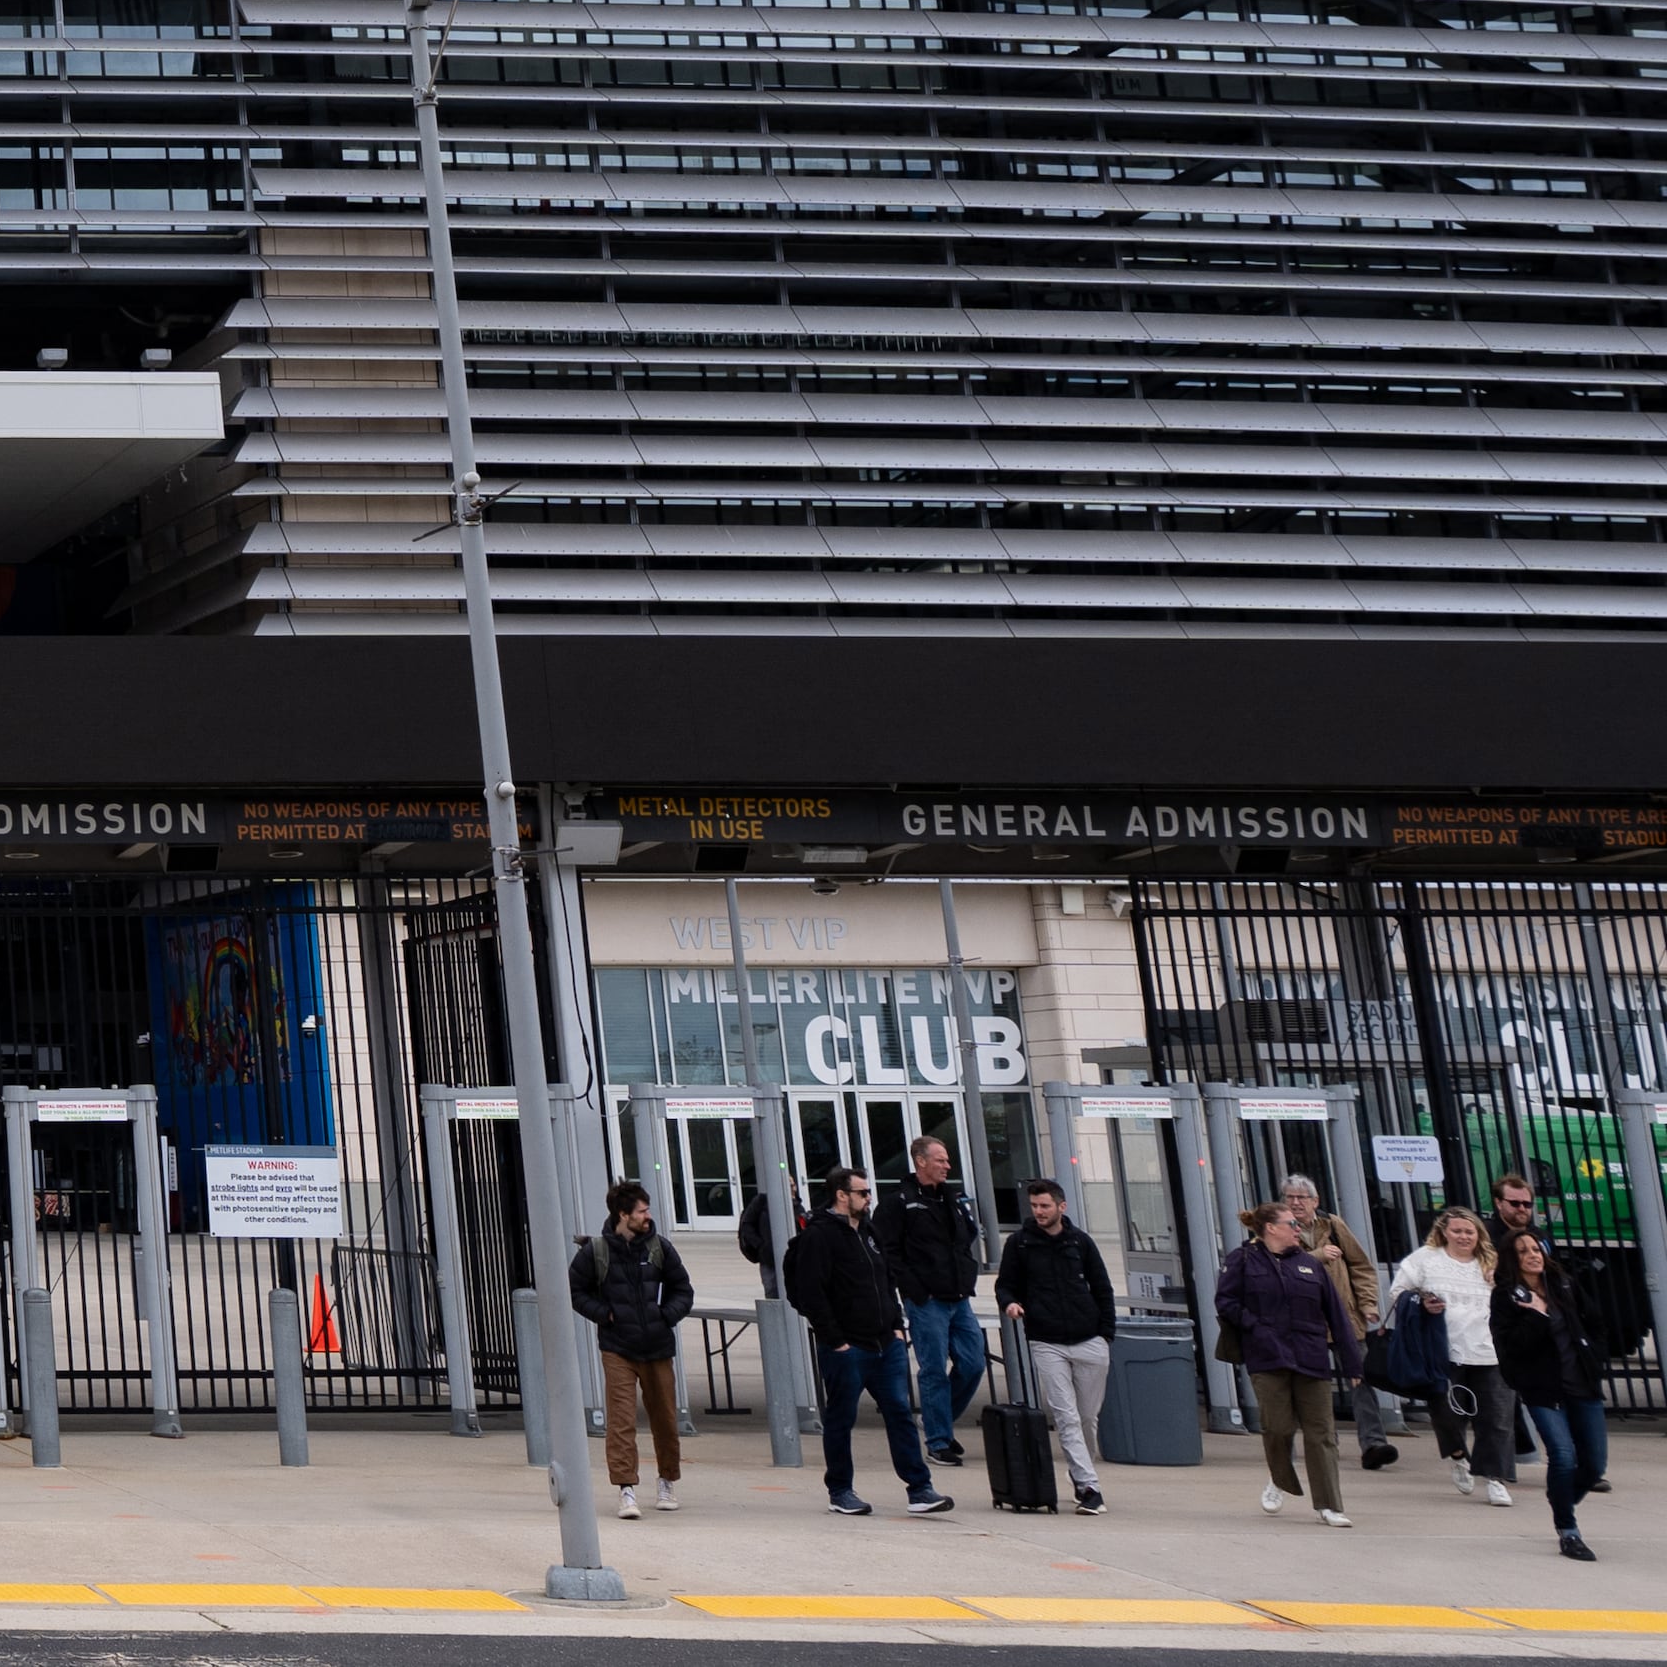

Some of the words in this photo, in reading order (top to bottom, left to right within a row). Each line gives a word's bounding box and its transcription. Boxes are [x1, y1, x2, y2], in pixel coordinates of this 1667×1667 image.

[243, 804, 269, 818] NO
[273, 803, 364, 818] WEAPONS
[367, 802, 390, 817] OF
[395, 802, 431, 816] ANY
[438, 802, 479, 817] TYPE
[619, 798, 693, 816] METAL
[699, 798, 831, 817] DETECTORS
[903, 804, 1106, 837] GENERAL
[1126, 806, 1368, 839] ADMISSION
[1397, 808, 1423, 822] NO
[1427, 808, 1515, 823] WEAPONS
[1519, 808, 1539, 824] OF
[1547, 809, 1580, 823] ANY
[1588, 809, 1630, 824] TYPE
[1636, 810, 1667, 824] ARE
[237, 824, 340, 840] PERMITTED
[345, 824, 363, 838] AT
[690, 821, 713, 838] IN
[720, 820, 763, 839] USE
[1393, 829, 1494, 844] PERMITTED
[1499, 830, 1517, 844] AT
[669, 917, 777, 950] WEST
[787, 918, 848, 950] VIP
[670, 969, 821, 1004] MILLER
[831, 971, 919, 1004] LITE
[933, 971, 1015, 1005] MVP
[805, 1015, 1026, 1085] CLUB
[248, 1161, 297, 1170] WARNING:
[211, 1184, 235, 1192] strobe
[291, 1206, 321, 1214] epilepsy
